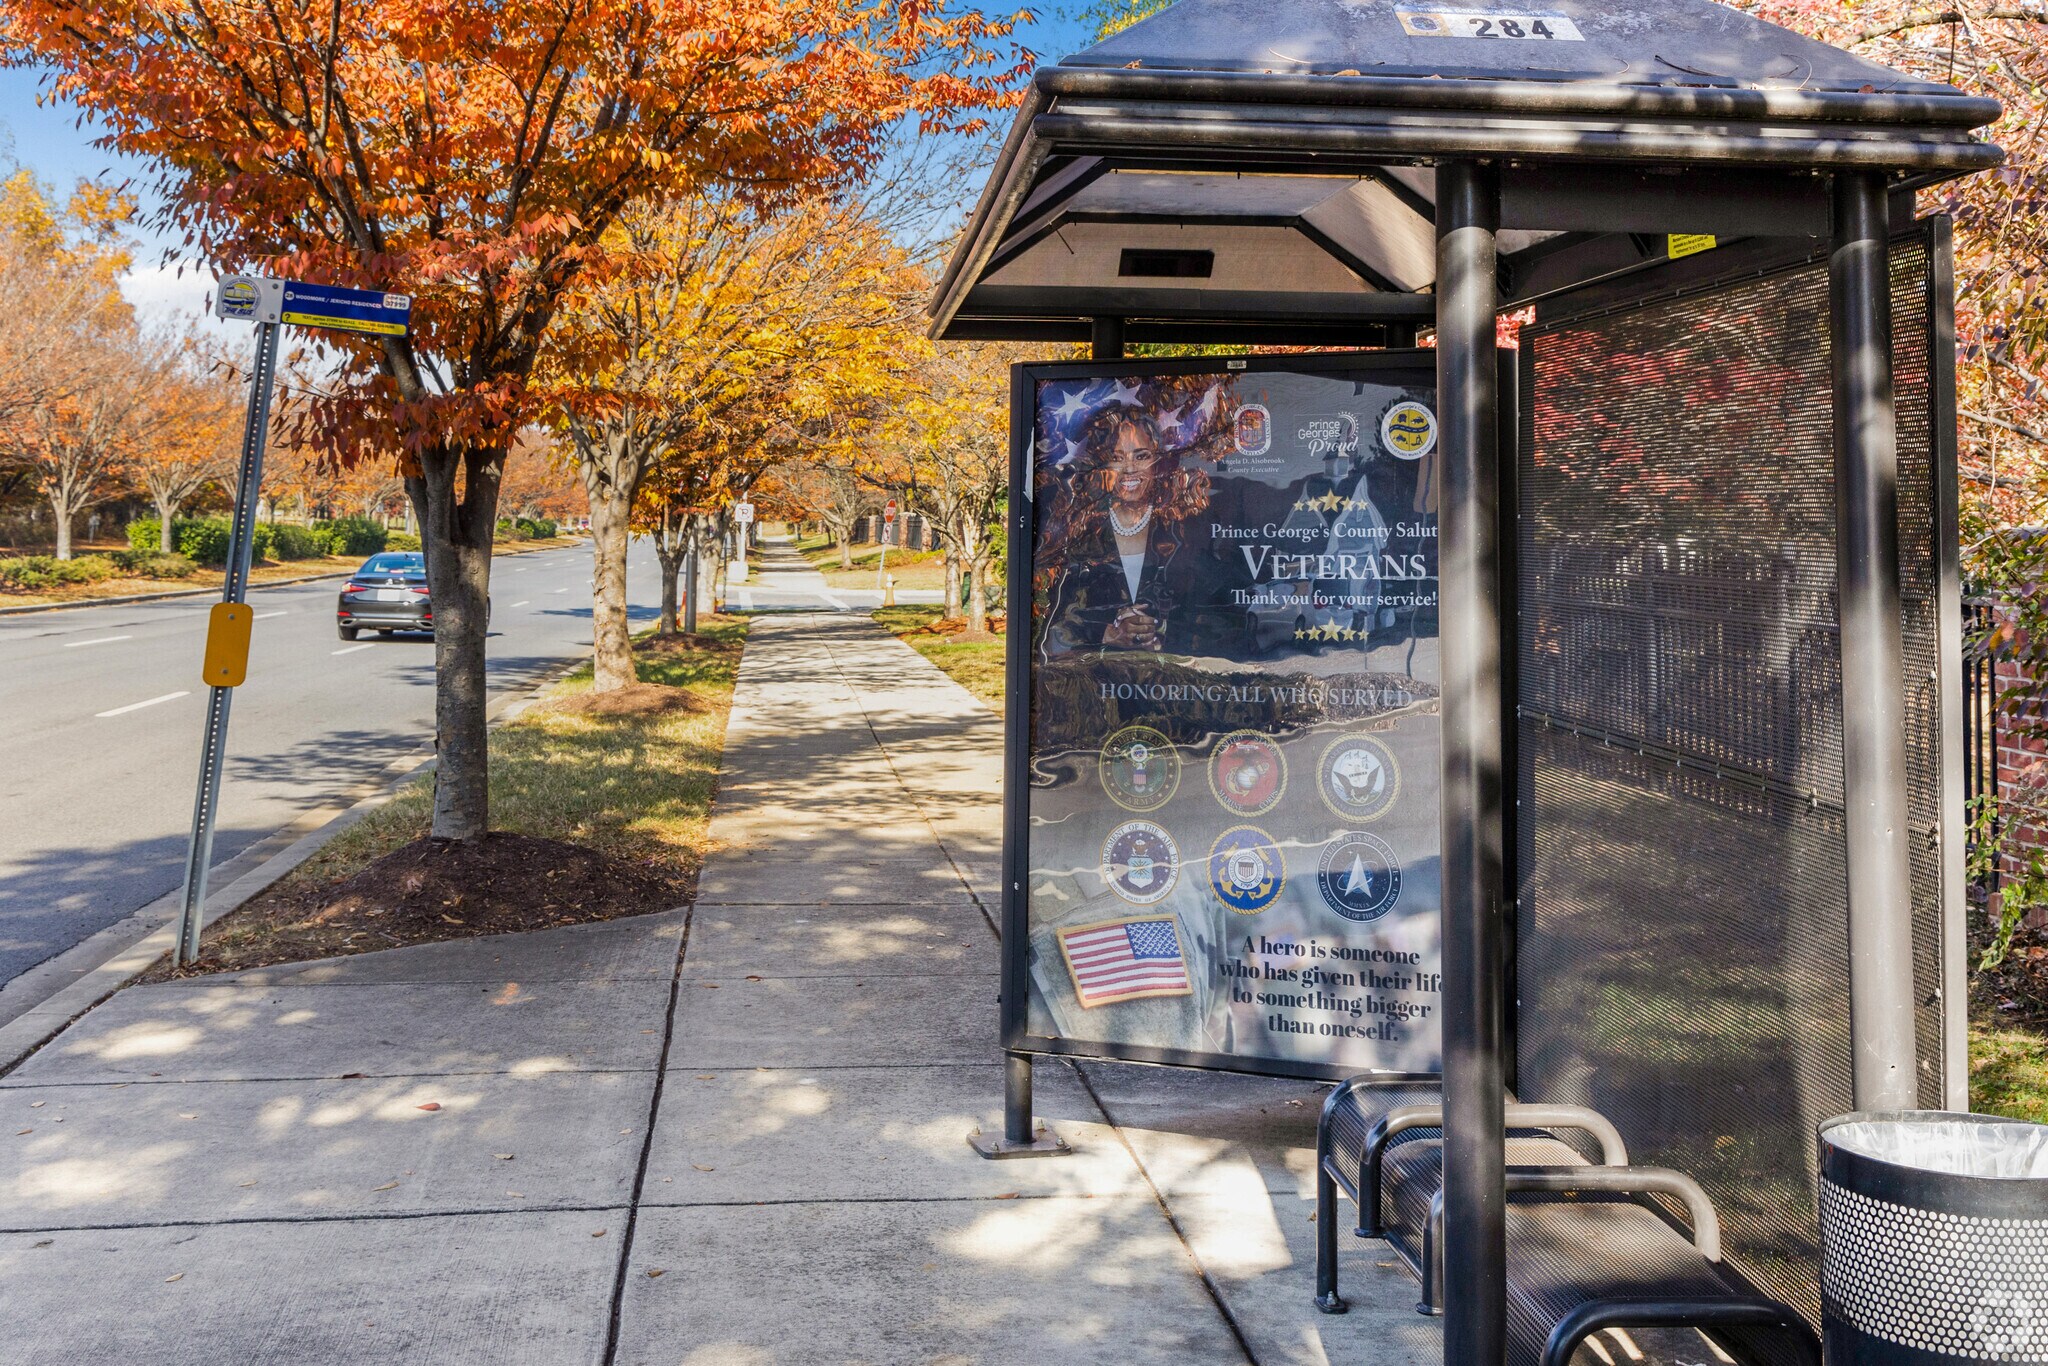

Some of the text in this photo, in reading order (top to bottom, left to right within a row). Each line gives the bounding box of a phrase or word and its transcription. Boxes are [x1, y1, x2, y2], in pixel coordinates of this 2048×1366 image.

[1468, 18, 1554, 39] 284
[296, 294, 325, 302] WOODMORE
[1308, 436, 1359, 456] Proud
[1210, 523, 1260, 539] Prince
[1263, 522, 1329, 544] George's
[1334, 522, 1393, 544] County
[1238, 544, 1426, 580] VETERANS
[1230, 588, 1437, 610] Thank you for your service!
[1101, 683, 1413, 707] HONORING ALL WHO SERVED
[1218, 735, 1243, 755] UNITED
[1125, 797, 1156, 805] ARMY
[1218, 789, 1279, 811] MARINE CORPS
[1104, 828, 1125, 875] DEPARTMENT
[1144, 824, 1160, 835] THE
[1162, 836, 1174, 849] AIR
[1170, 853, 1178, 881] FORCE
[1320, 834, 1399, 876] UNITED STATES SPACE FORCE
[1320, 881, 1350, 916] DEPARTMENT
[1376, 905, 1386, 915] AIR
[1386, 888, 1398, 908] FORCE
[1242, 936, 1420, 965] A hero is someone
[1220, 961, 1260, 981] who
[1263, 962, 1298, 982] has
[1301, 966, 1356, 989] given
[1359, 969, 1412, 991] their
[1232, 987, 1432, 1022] to something bigger
[1268, 1014, 1399, 1042] than oneself.
